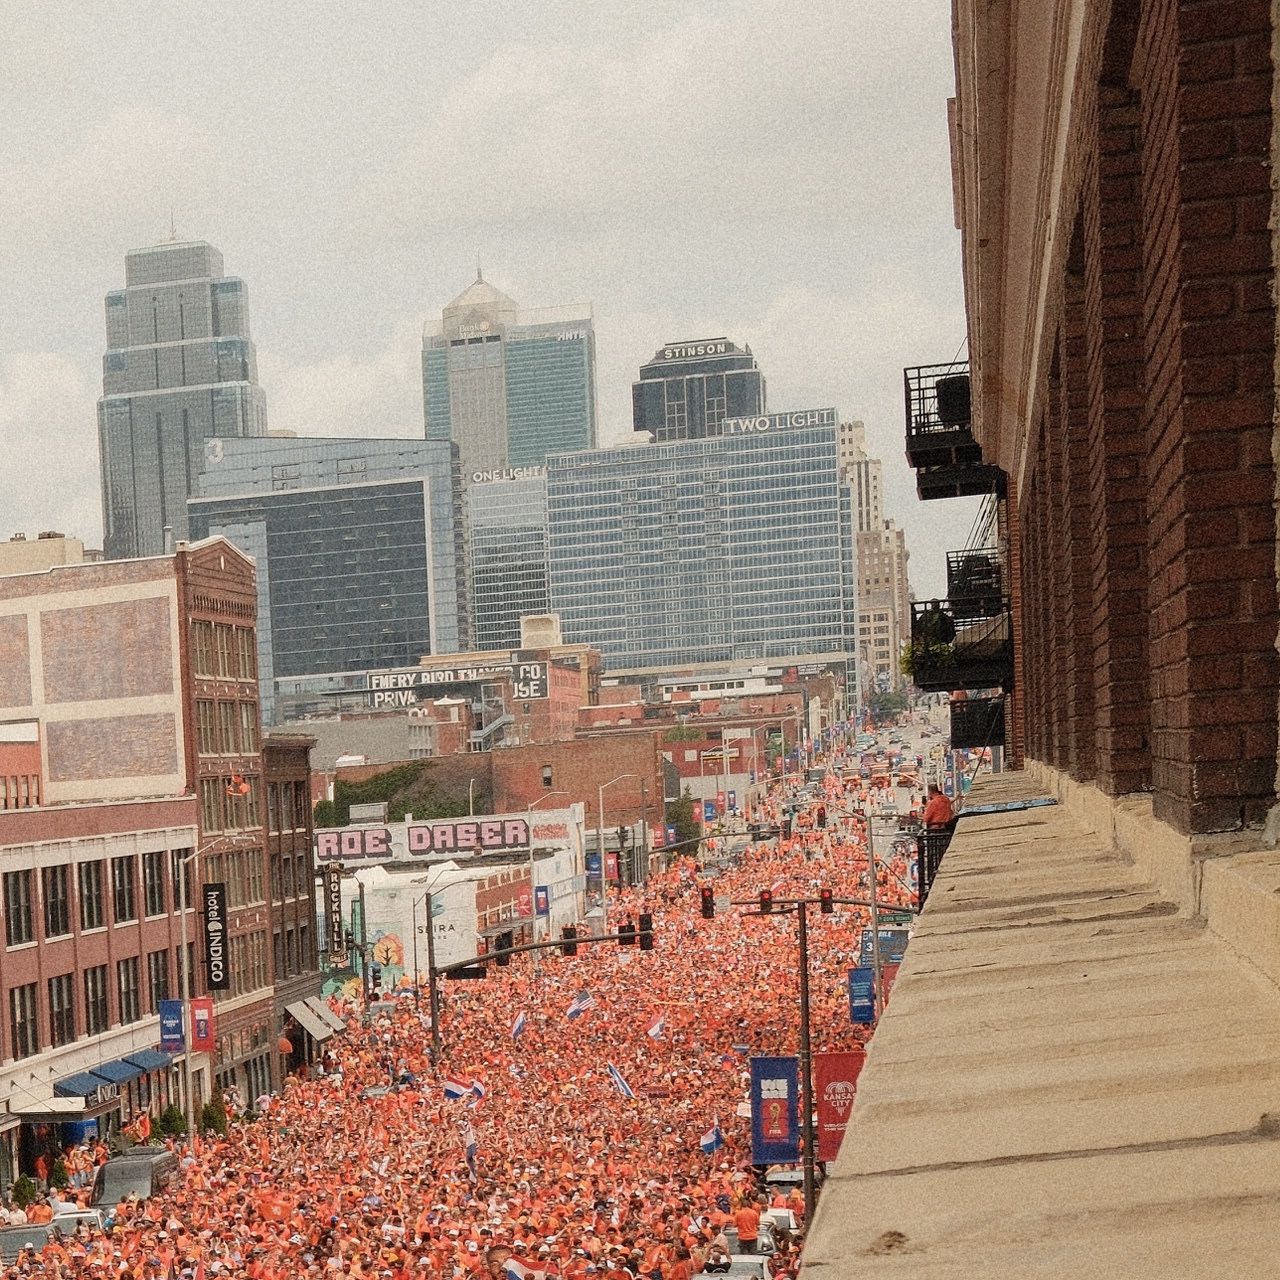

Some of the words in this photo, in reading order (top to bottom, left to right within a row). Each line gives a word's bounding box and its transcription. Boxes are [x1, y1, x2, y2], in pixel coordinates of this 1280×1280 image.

[664, 343, 726, 359] STINSON
[726, 416, 770, 433] TWO
[775, 410, 832, 428] LIGHT
[473, 469, 501, 482] ONE
[503, 465, 541, 480] LIGHT
[371, 672, 416, 689] EMERY
[519, 665, 546, 680] CO.
[373, 690, 417, 707] PRIVA
[317, 828, 393, 861] ROE
[407, 819, 531, 856] DASER
[207, 892, 221, 920] hotel
[330, 873, 341, 951] ROCKHILL
[417, 924, 456, 934] SIRA
[209, 930, 224, 982] INDIGO
